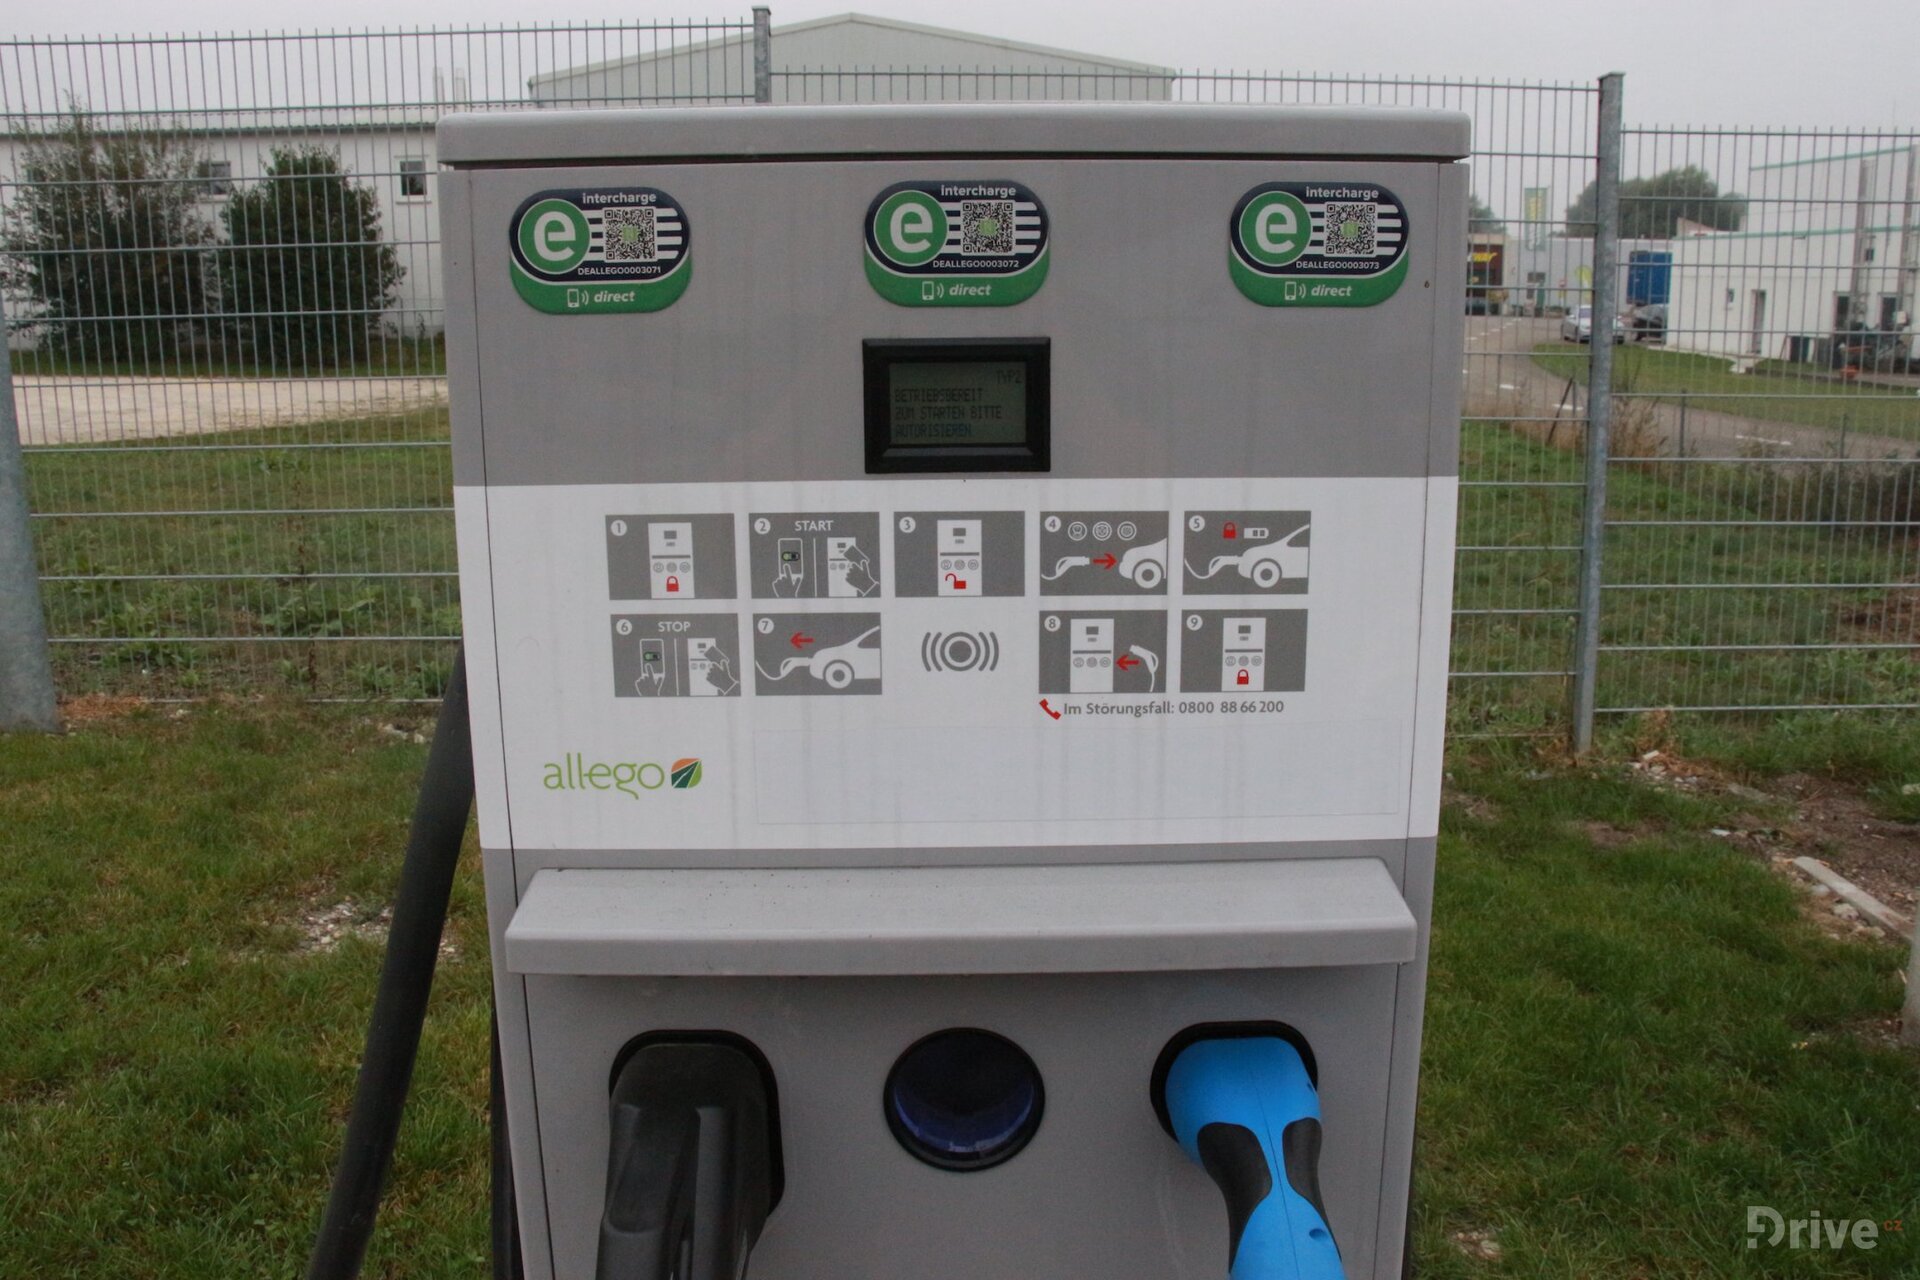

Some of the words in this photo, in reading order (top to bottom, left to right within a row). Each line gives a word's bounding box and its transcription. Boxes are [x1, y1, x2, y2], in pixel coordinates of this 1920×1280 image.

[941, 184, 1017, 198] intercharge
[1305, 186, 1380, 201] intercharge
[582, 192, 657, 205] intercharge
[889, 202, 934, 253] e
[1255, 203, 1298, 254] e
[533, 211, 577, 262] e
[949, 283, 993, 296] direct
[1310, 284, 1353, 297] direct
[593, 290, 636, 304] direct
[894, 387, 984, 403] BETRIEBSBEREIT
[920, 405, 966, 420] STARTEN
[970, 405, 1003, 420] BITTE
[894, 422, 972, 438] AUTORISIEREN
[759, 521, 767, 533] 2
[794, 520, 834, 532] START
[903, 519, 911, 531] 3
[1048, 518, 1057, 531] 4
[1193, 517, 1200, 530] 5
[620, 621, 629, 634] 6
[657, 621, 691, 633] STOP
[761, 620, 770, 632] 7
[1048, 617, 1057, 630] 8
[1191, 616, 1199, 629] 9
[1063, 702, 1082, 715] Im
[1086, 701, 1175, 718] Störungsfall:
[1178, 701, 1214, 714] 0800
[543, 752, 665, 800] allego
